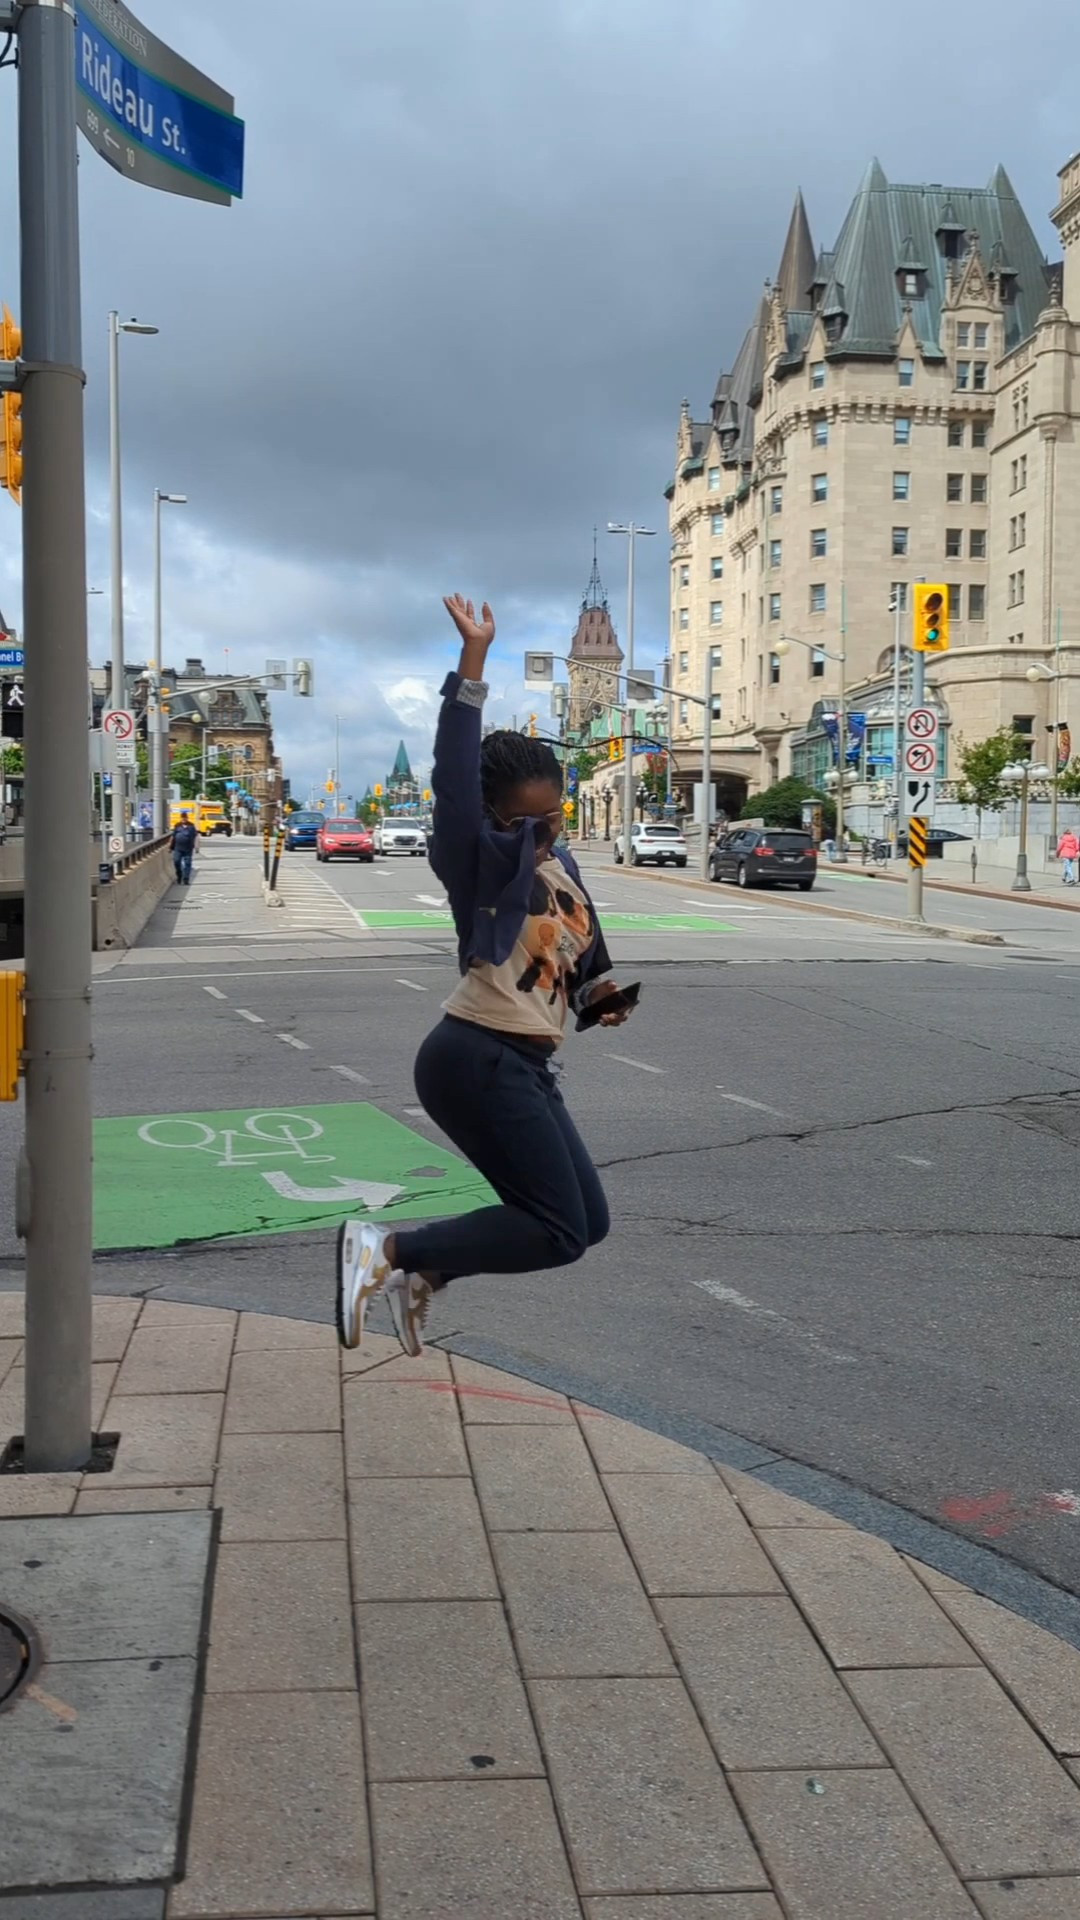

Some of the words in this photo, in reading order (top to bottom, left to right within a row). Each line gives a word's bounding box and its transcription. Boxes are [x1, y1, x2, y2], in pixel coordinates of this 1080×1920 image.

[82, 31, 153, 138] Rideau
[161, 116, 185, 155] St.
[126, 147, 135, 168] 10
[0, 651, 14, 662] nel
